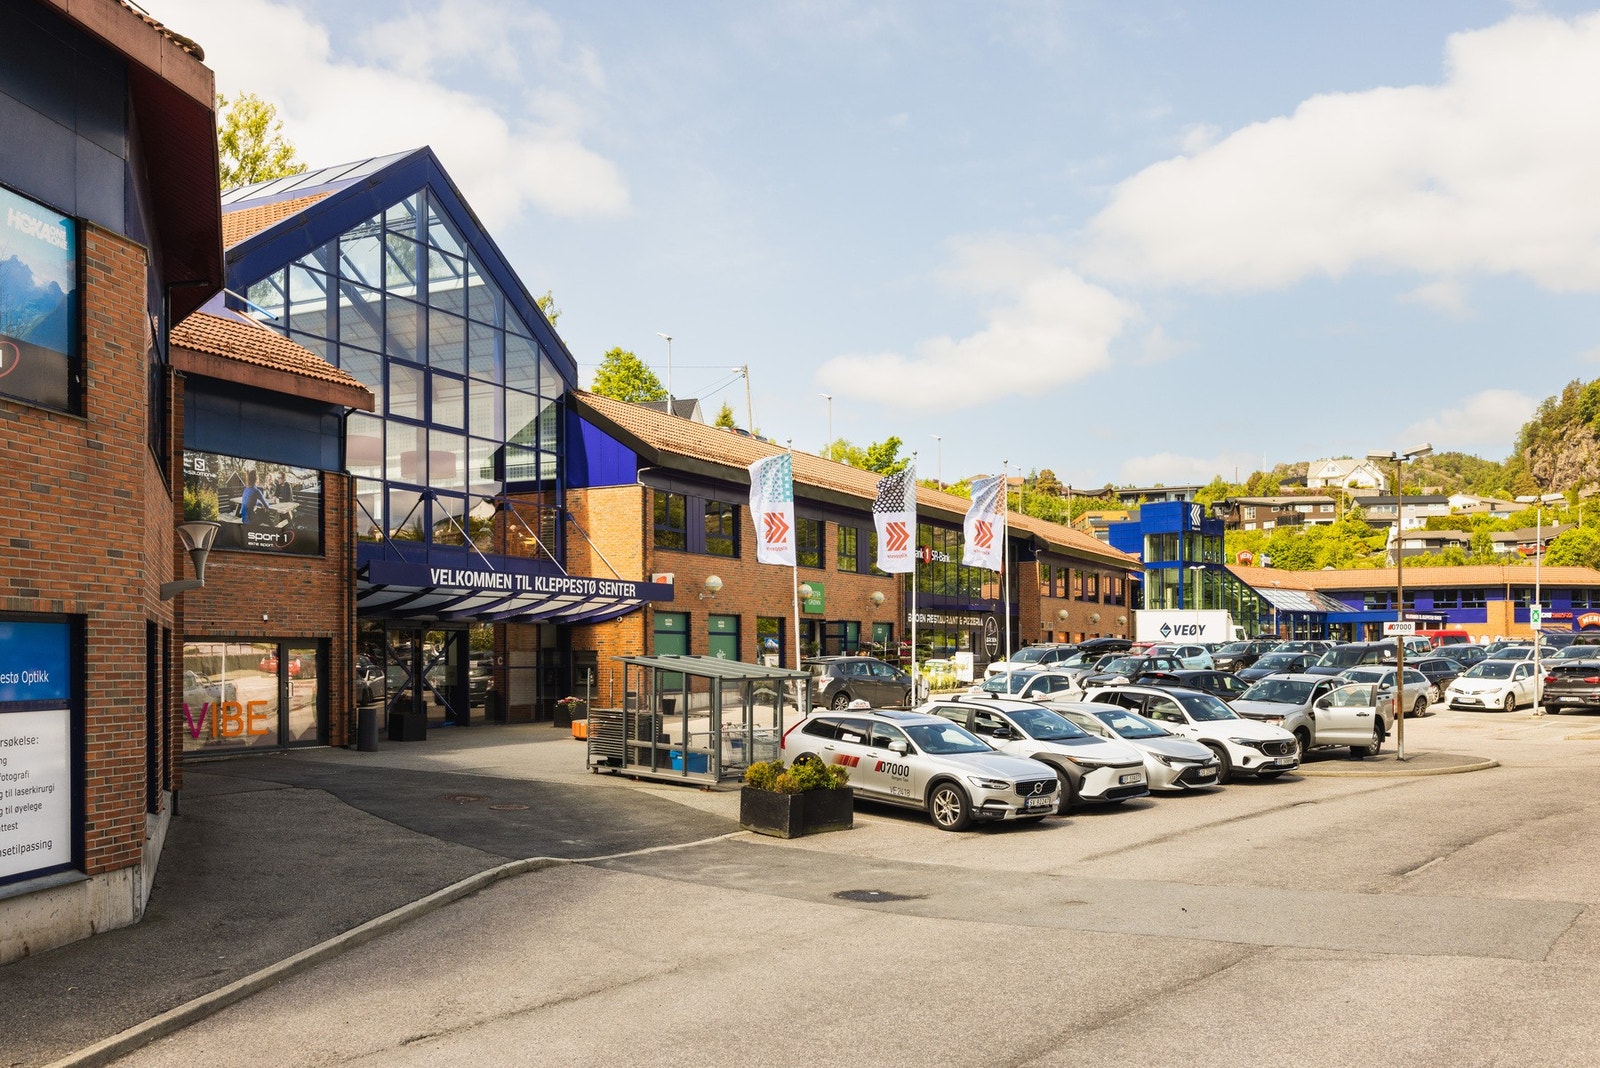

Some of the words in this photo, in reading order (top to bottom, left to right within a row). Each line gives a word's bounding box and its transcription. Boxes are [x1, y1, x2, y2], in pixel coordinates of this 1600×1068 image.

[7, 207, 50, 240] HOKA
[247, 531, 280, 542] sport
[430, 568, 512, 590] VELKOMMEN
[515, 574, 533, 591] TIL
[534, 576, 597, 596] KLEPPESTØ
[598, 580, 637, 598] SENTER
[907, 613, 927, 623] BOEN
[1173, 624, 1207, 636] VEØY
[1391, 623, 1412, 631] 07000
[21, 670, 50, 686] Optikk
[183, 700, 269, 739] VIBE
[880, 761, 910, 777] 07000
[5, 788, 13, 798] til
[14, 783, 55, 796] laserkirurgi
[5, 805, 13, 814] til
[14, 802, 43, 814] øyelege
